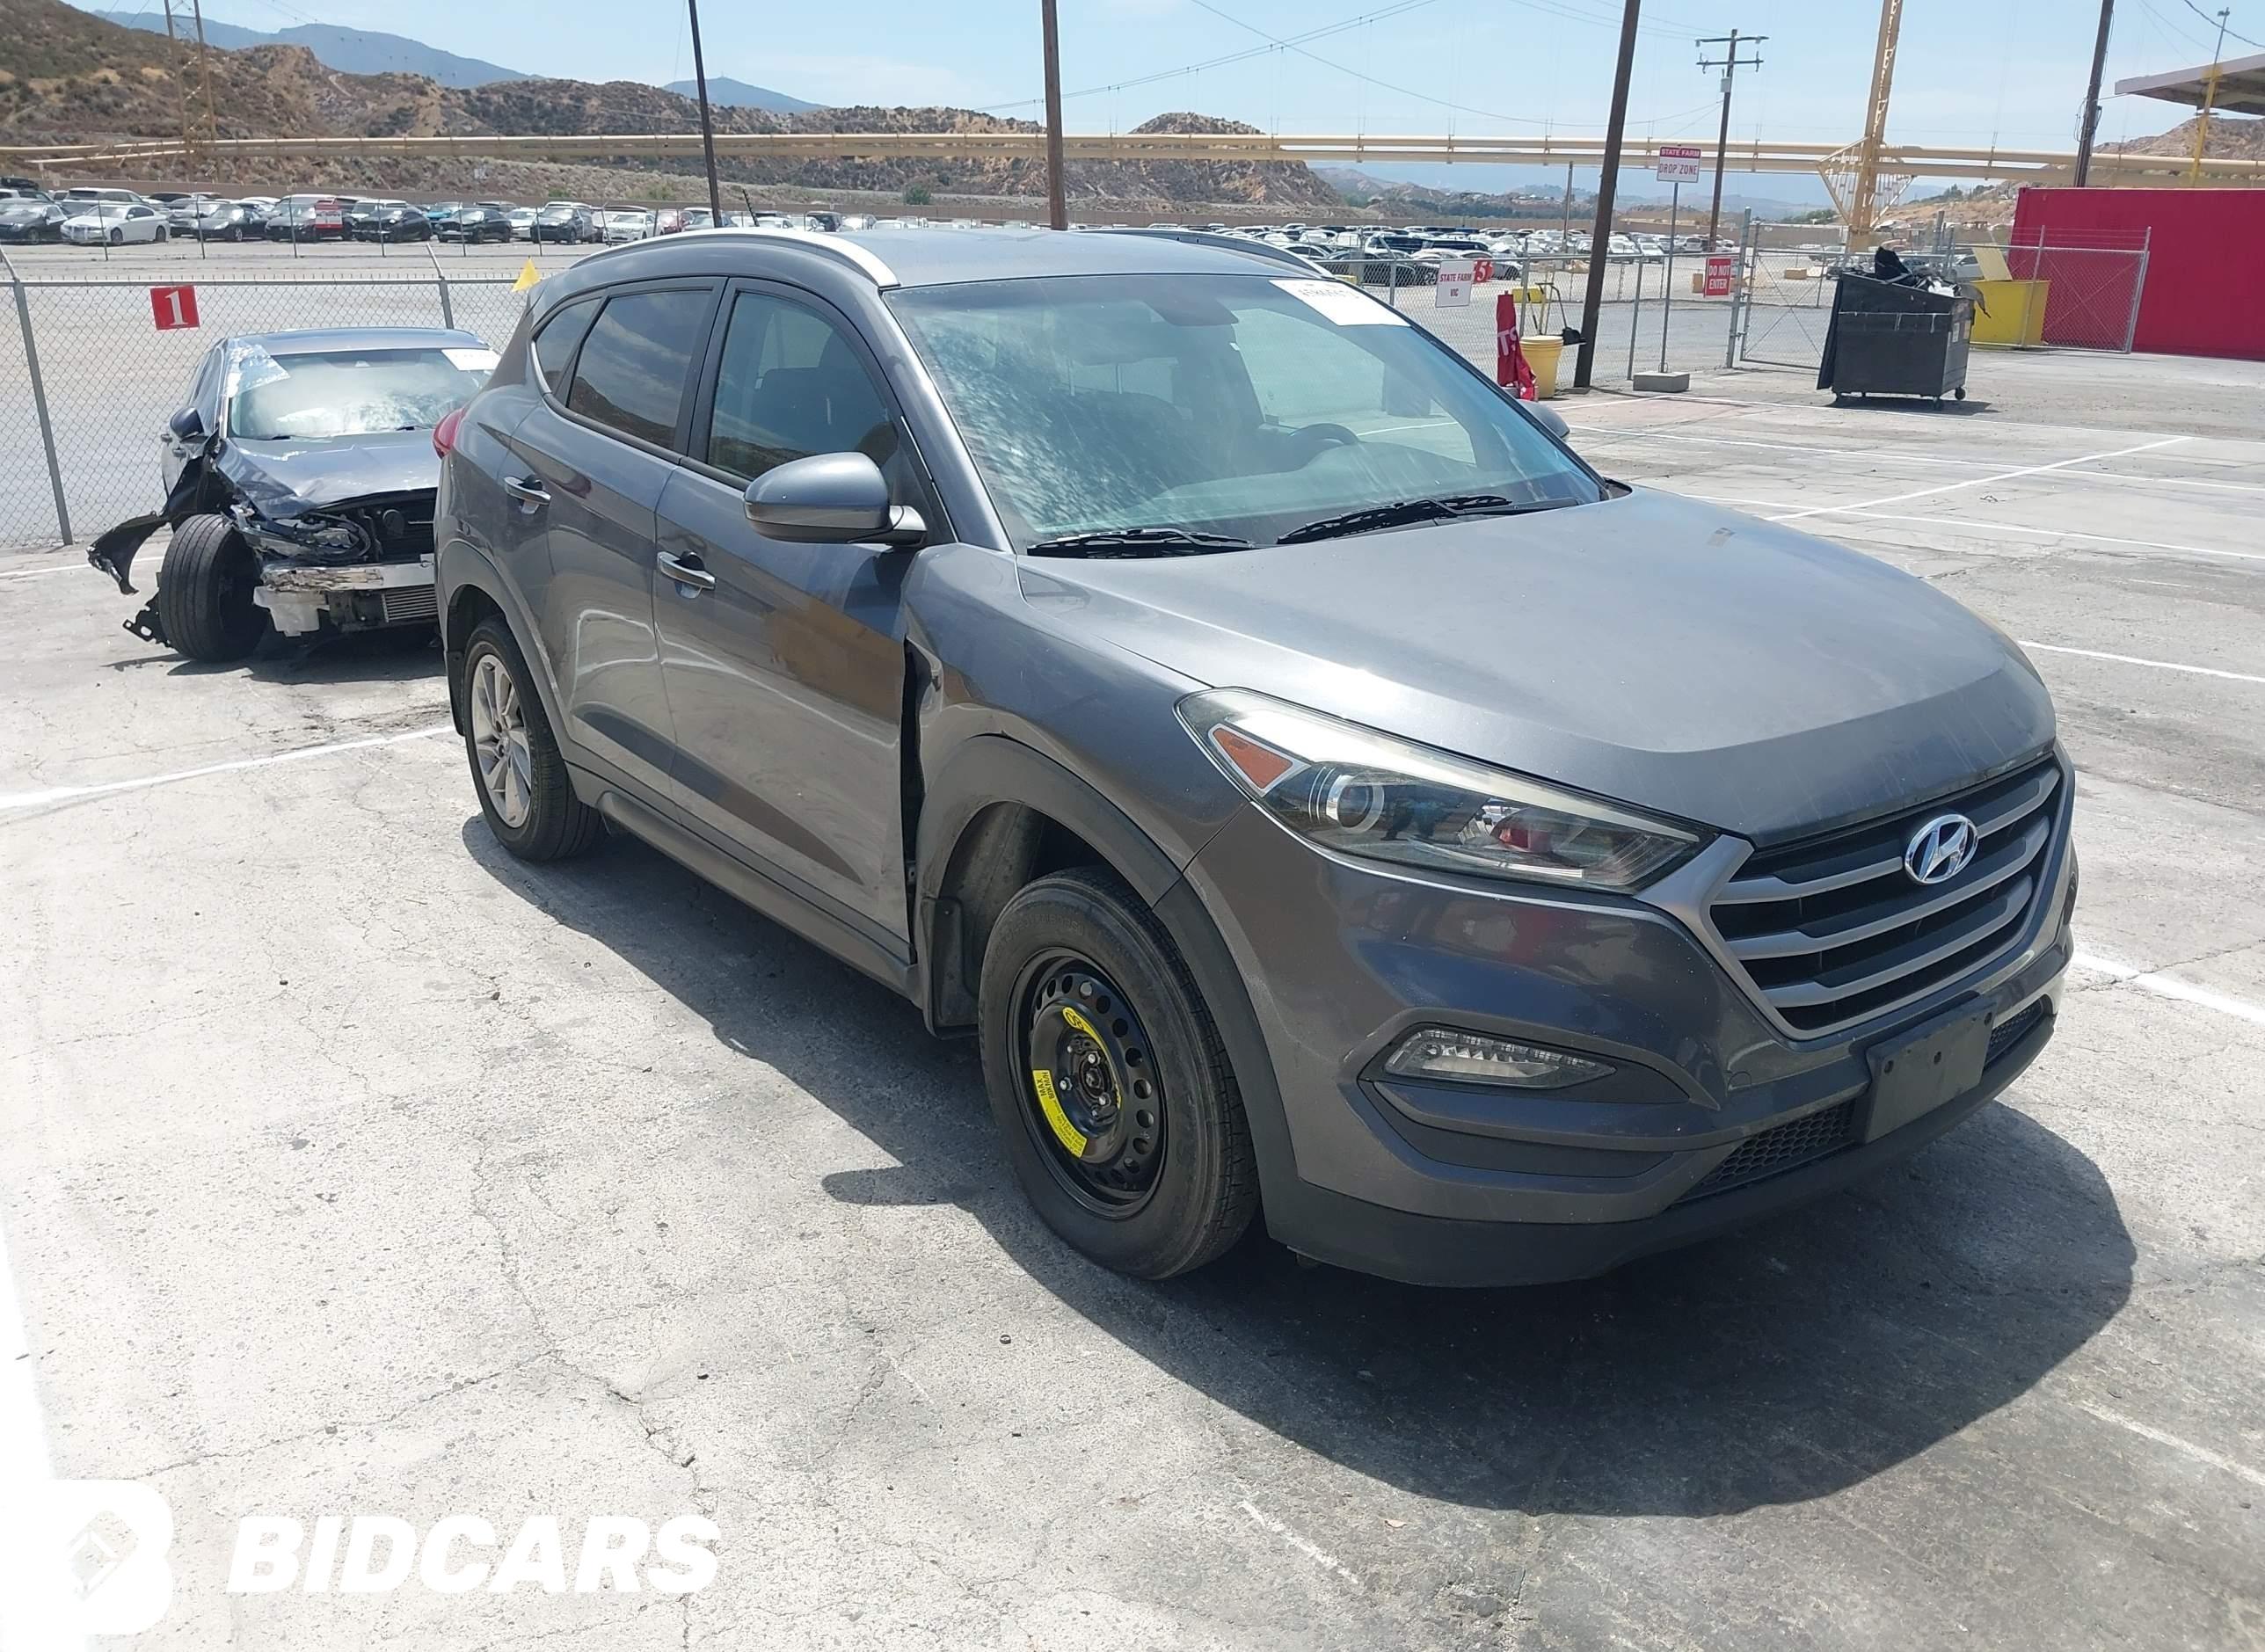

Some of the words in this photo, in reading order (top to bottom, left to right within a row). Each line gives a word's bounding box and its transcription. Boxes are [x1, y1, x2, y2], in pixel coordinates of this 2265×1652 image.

[1661, 148, 1680, 156] STATE
[1681, 149, 1700, 157] FARM
[1659, 164, 1678, 174] DROP
[1679, 164, 1698, 175] ZONE
[1708, 266, 1717, 276] DO
[1718, 265, 1730, 276] NOT
[1439, 273, 1457, 282] STATE
[1708, 278, 1729, 290] ENTER
[164, 290, 189, 326] 1
[1037, 1078, 1048, 1097] MAX
